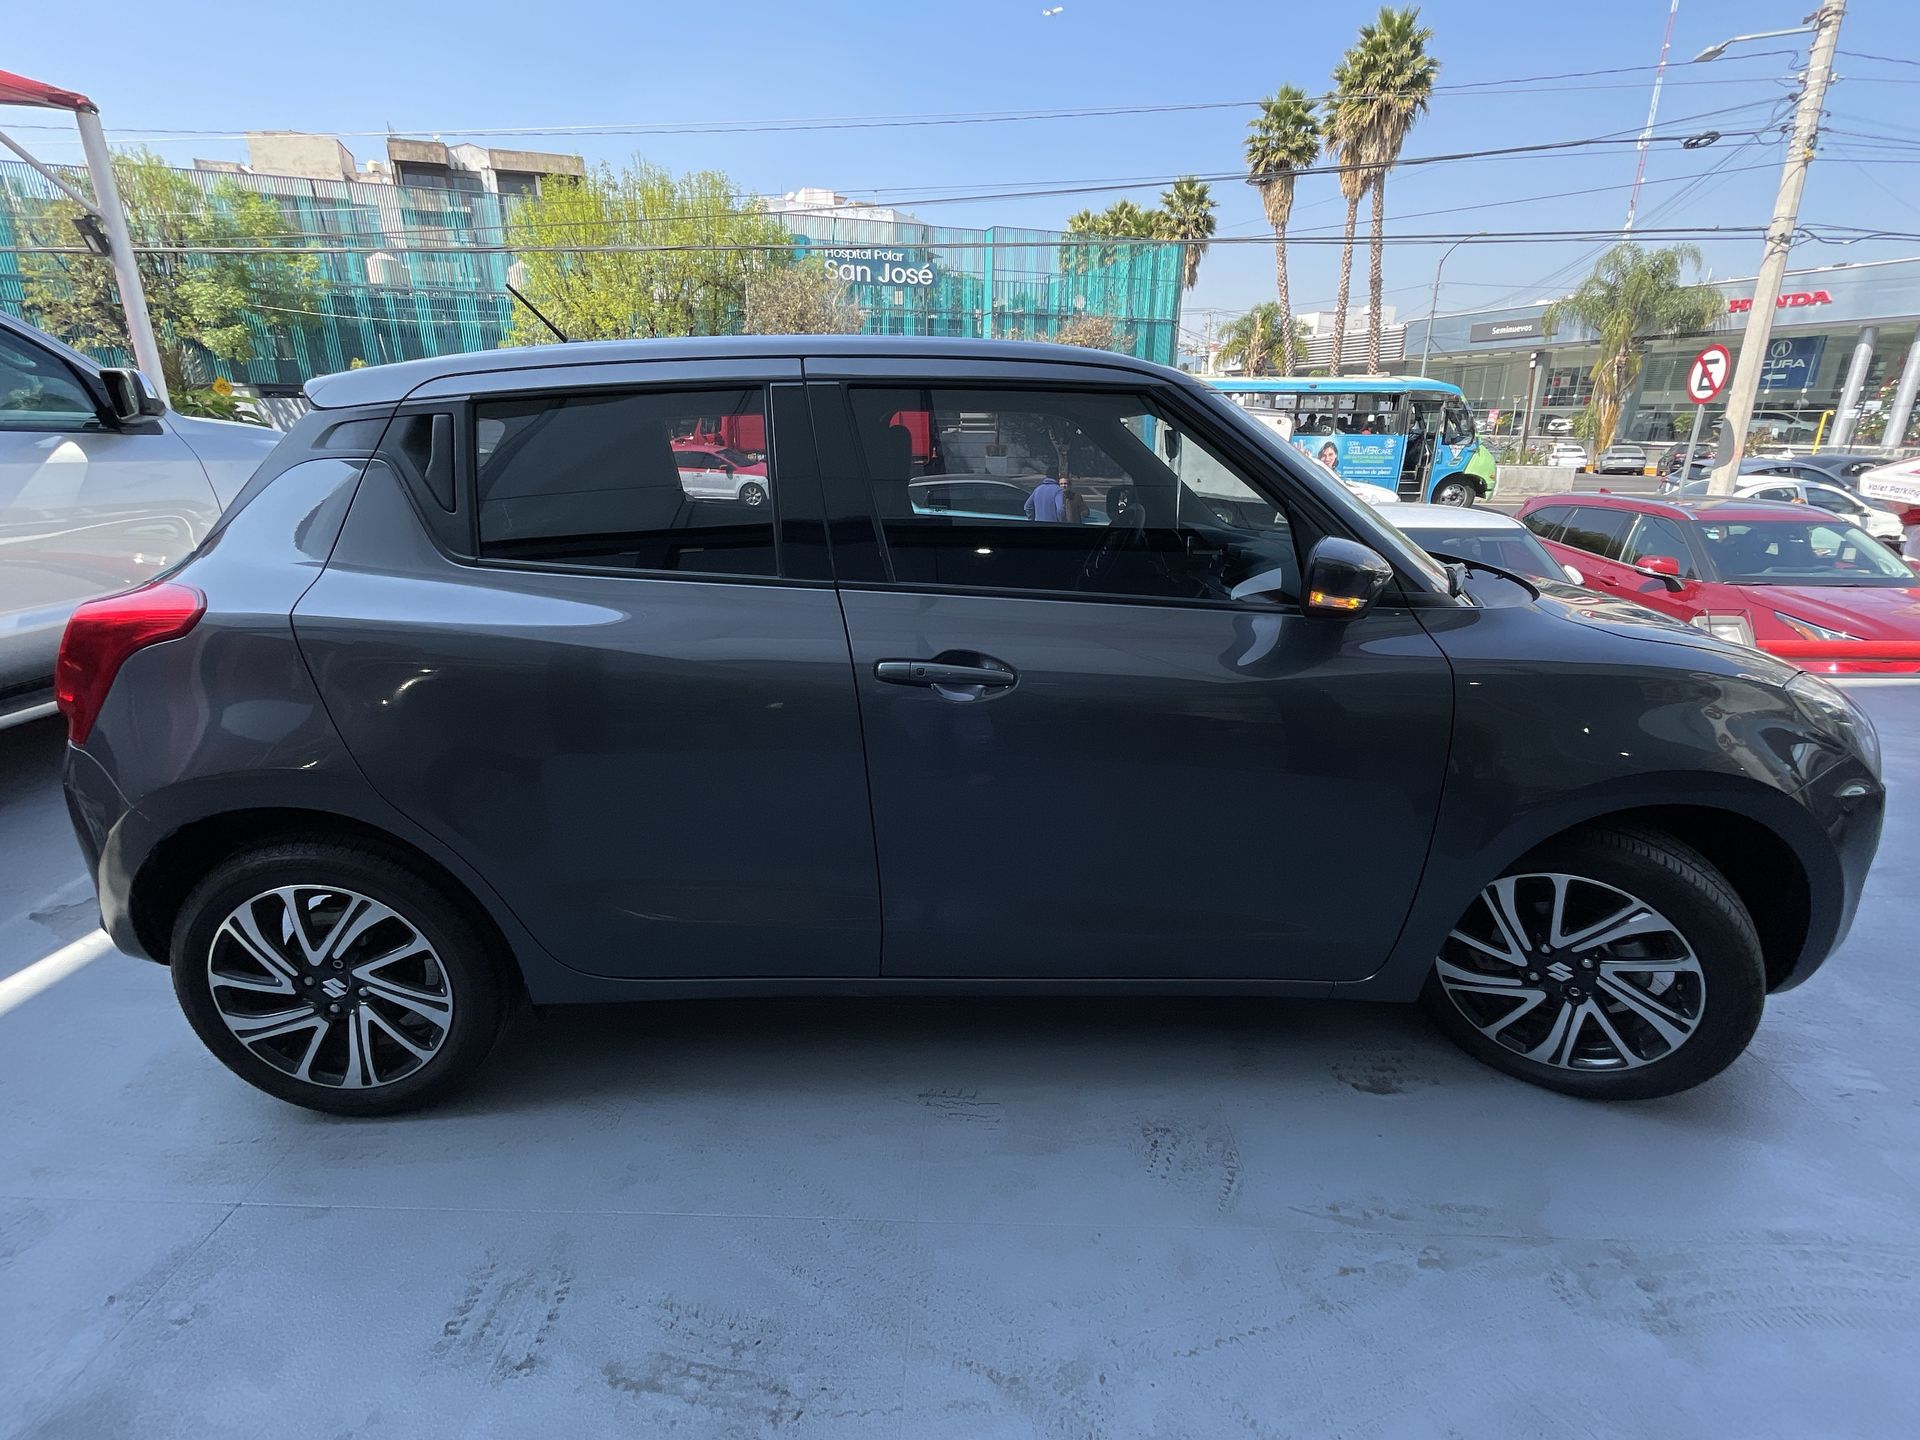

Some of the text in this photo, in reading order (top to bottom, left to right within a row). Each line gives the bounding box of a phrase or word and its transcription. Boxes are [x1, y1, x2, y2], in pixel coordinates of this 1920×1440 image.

[825, 248, 904, 262] Hospital Polar
[824, 260, 933, 285] San José
[1728, 290, 1832, 313] HNDA
[1491, 324, 1533, 335] Seminuevos
[1763, 358, 1806, 369] CURA
[1868, 482, 1888, 491] Valet
